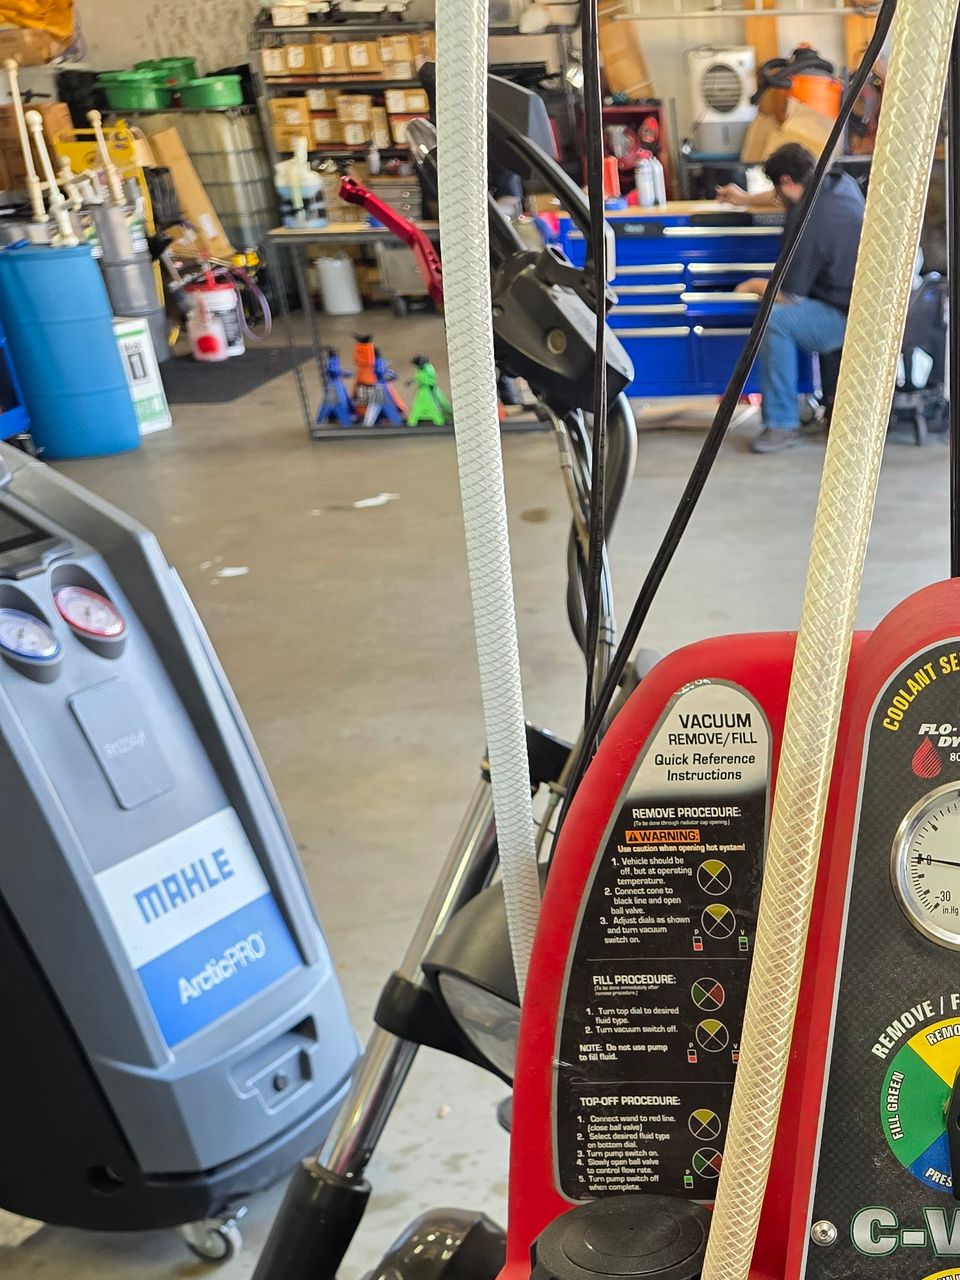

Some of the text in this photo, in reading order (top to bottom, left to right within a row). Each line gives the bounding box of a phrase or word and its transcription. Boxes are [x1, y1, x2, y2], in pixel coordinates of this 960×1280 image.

[882, 663, 938, 732] COOLANT
[679, 713, 751, 729] VACUUM
[918, 724, 957, 734] FLO-
[655, 753, 755, 768] Quick Reference
[667, 769, 742, 781] Instructions
[633, 807, 741, 818] REMOVE PROCEDURE:
[640, 831, 699, 841] WARNING:
[621, 857, 648, 865] Vehicle
[134, 848, 235, 924] MAHLE
[176, 931, 266, 1006] ArcticPRO
[593, 975, 676, 984] FILL PROCEDURE:
[872, 1000, 935, 1059] REMOVE
[940, 997, 944, 1015] /
[887, 1072, 905, 1140] FILL GREEN
